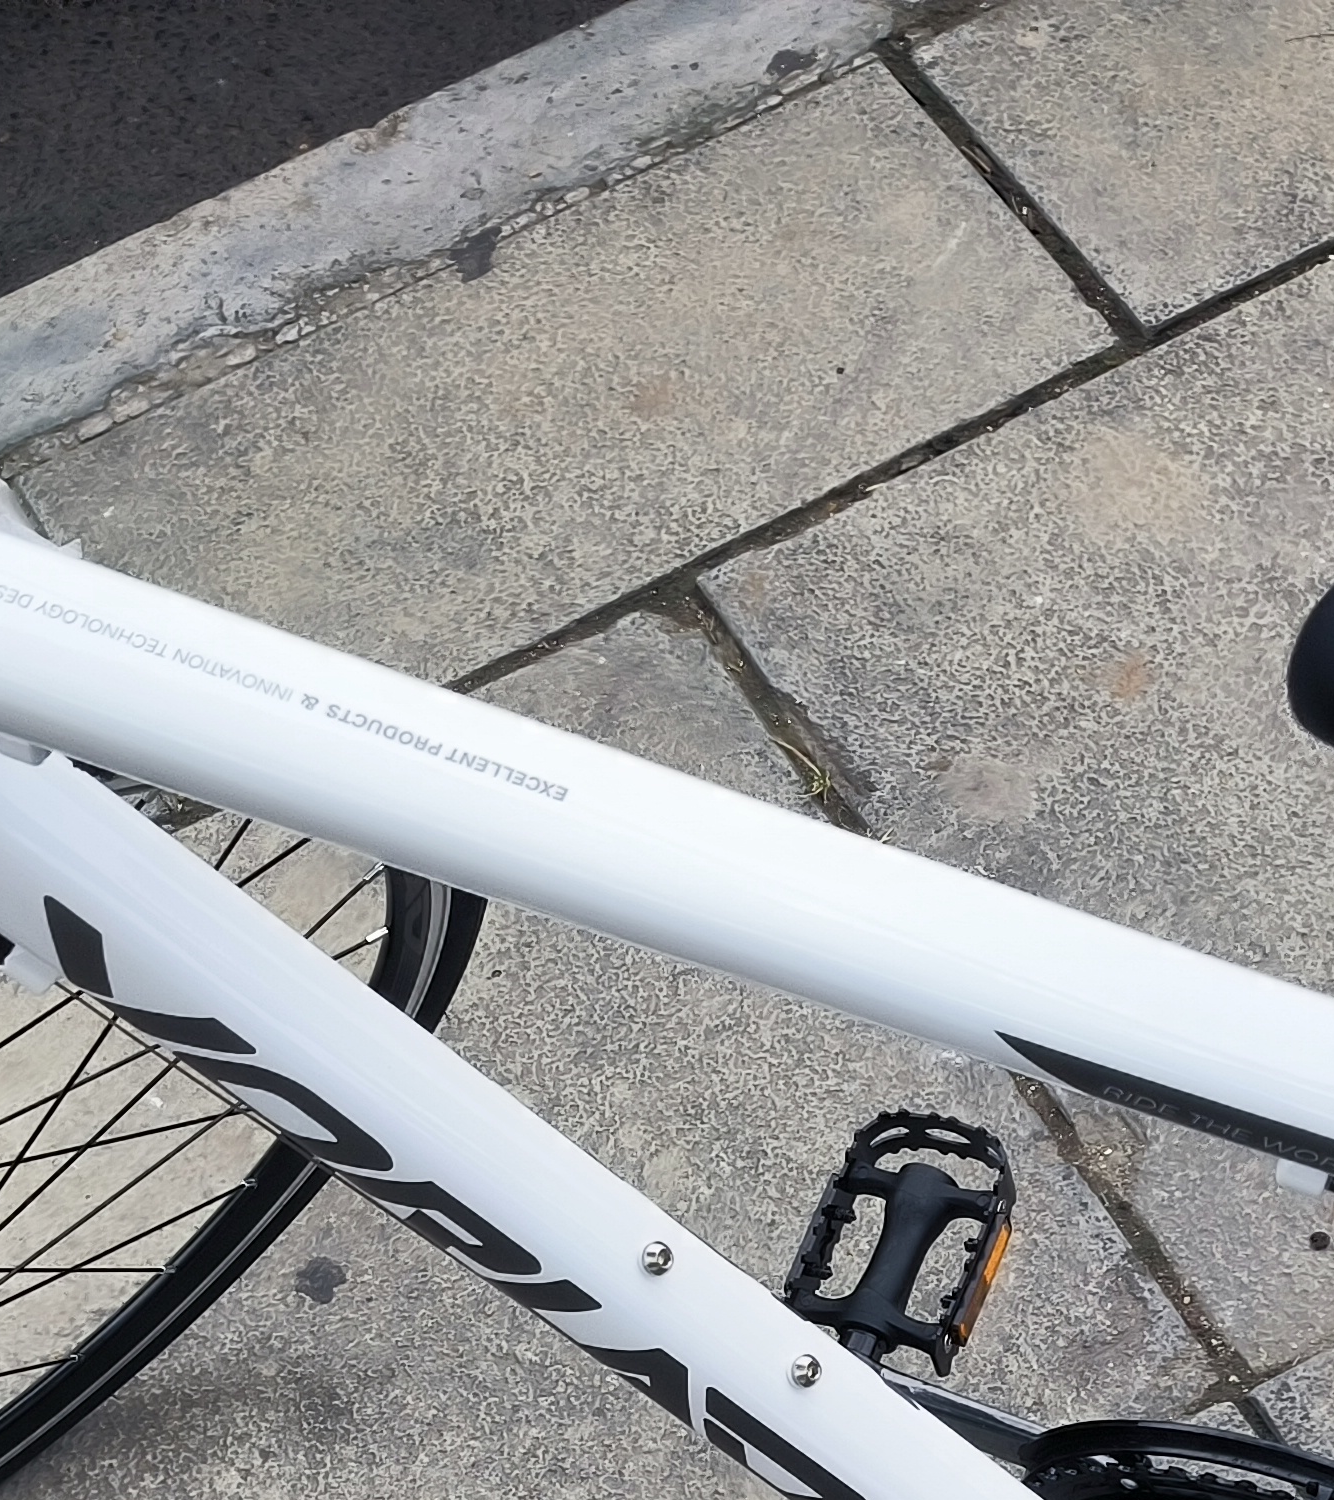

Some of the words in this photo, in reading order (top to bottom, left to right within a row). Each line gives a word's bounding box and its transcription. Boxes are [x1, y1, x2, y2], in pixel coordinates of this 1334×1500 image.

[34, 601, 169, 657] TECHNOLOGY
[173, 649, 294, 702] INNOVATION
[300, 692, 322, 711] &
[326, 703, 442, 757] PRODUCTS
[446, 749, 569, 802] EXCELLENT
[1101, 1085, 1180, 1117] RIDE
[1188, 1110, 1254, 1145] THE
